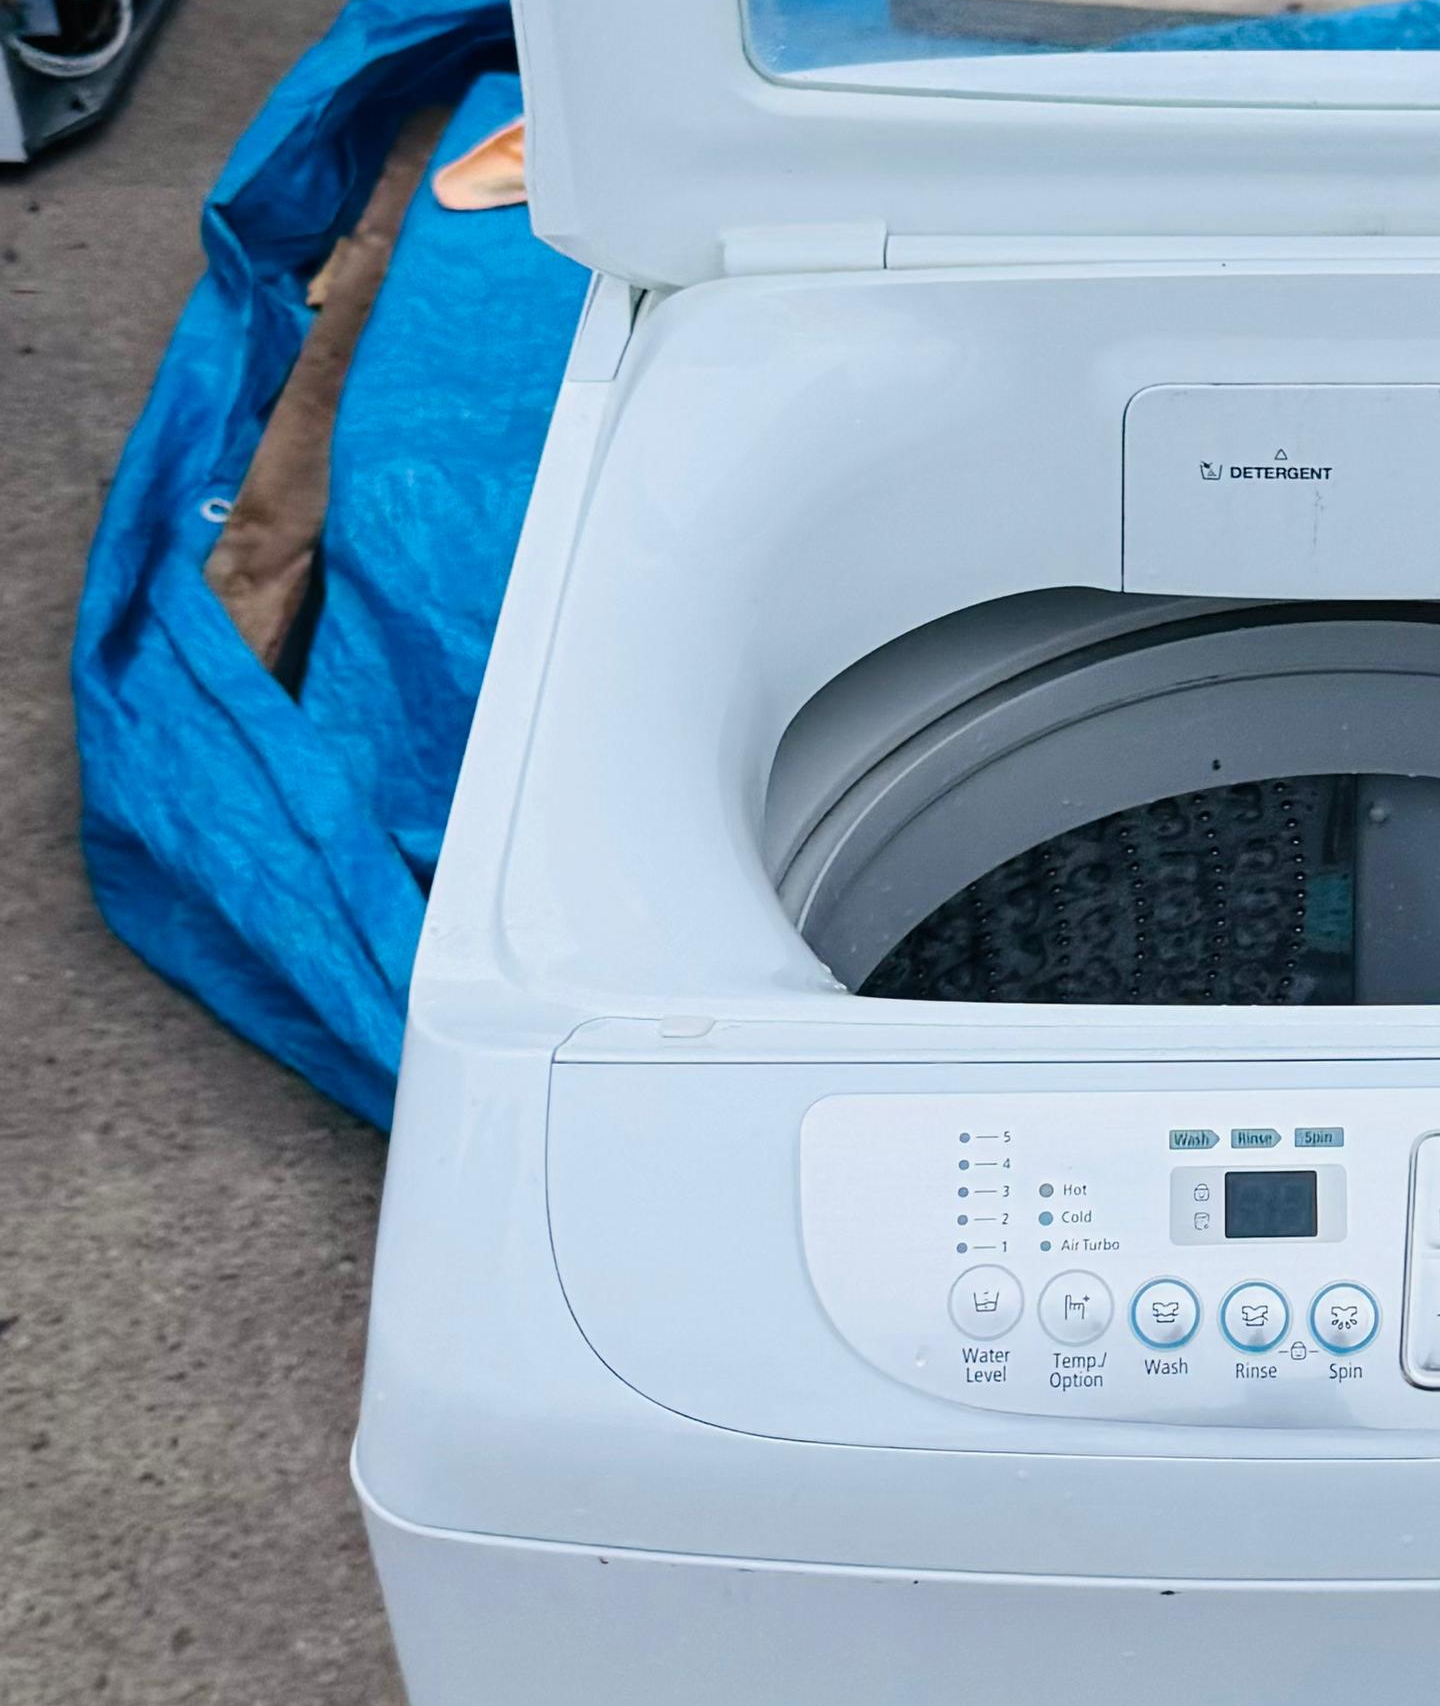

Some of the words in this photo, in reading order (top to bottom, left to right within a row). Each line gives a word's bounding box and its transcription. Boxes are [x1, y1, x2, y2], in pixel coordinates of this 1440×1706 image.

[1229, 466, 1332, 481] DETERGENT
[1003, 1130, 1012, 1143] 5
[1174, 1131, 1210, 1146] Wash
[1238, 1130, 1273, 1144] Rinse
[1304, 1130, 1333, 1144] Spin
[1002, 1158, 1011, 1169] 4
[1002, 1185, 1010, 1197] 3
[1063, 1183, 1087, 1196] Hot
[1001, 1212, 1009, 1225] 2
[1061, 1210, 1093, 1224] Cold
[1002, 1240, 1008, 1253] 1
[1061, 1238, 1079, 1251] Air
[1083, 1238, 1120, 1251] Turbo
[962, 1348, 1010, 1364] Water
[1053, 1352, 1107, 1372] Temp./
[1144, 1358, 1188, 1375] Wash
[1235, 1362, 1277, 1379] Rinse
[1329, 1363, 1363, 1383] Spin
[966, 1366, 1007, 1383] Level
[1049, 1371, 1103, 1392] Option
